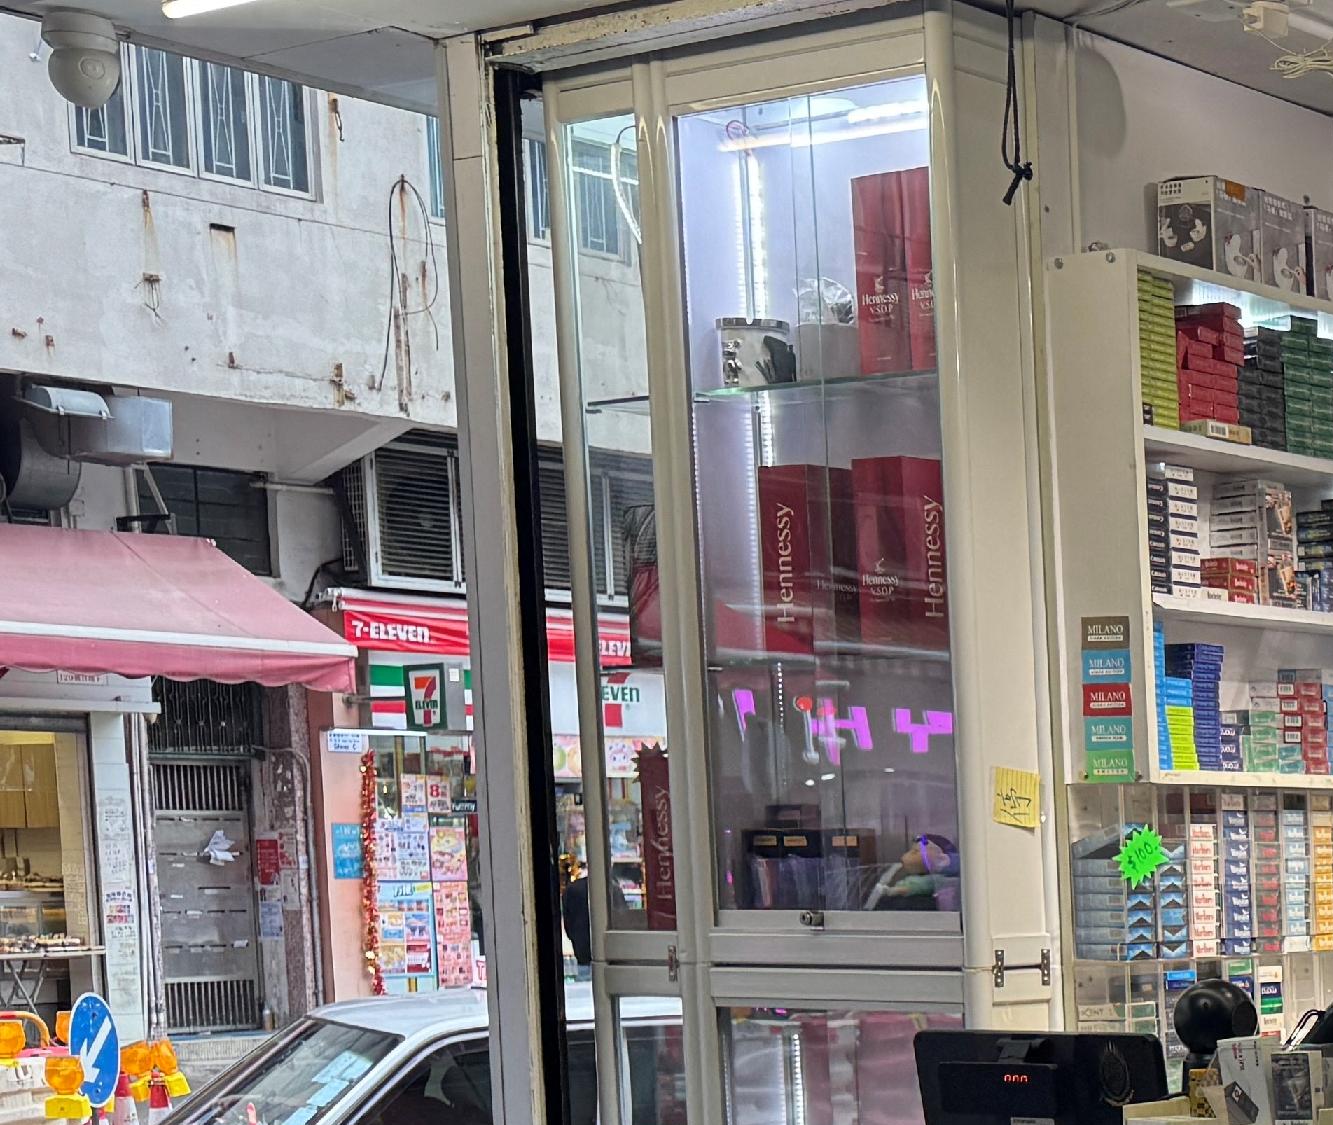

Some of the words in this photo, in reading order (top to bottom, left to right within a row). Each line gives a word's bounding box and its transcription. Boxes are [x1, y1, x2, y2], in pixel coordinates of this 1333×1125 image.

[862, 292, 899, 308] Hennessy
[777, 502, 795, 623] Hennessy
[862, 573, 899, 590] Hennessy
[351, 620, 430, 643] 7-ELEVEN
[1087, 624, 1124, 636] MILANO
[1089, 657, 1124, 669] MILANO
[1090, 690, 1126, 702] MILANO
[1091, 724, 1127, 735] MILANO
[1093, 757, 1128, 769] MILANO
